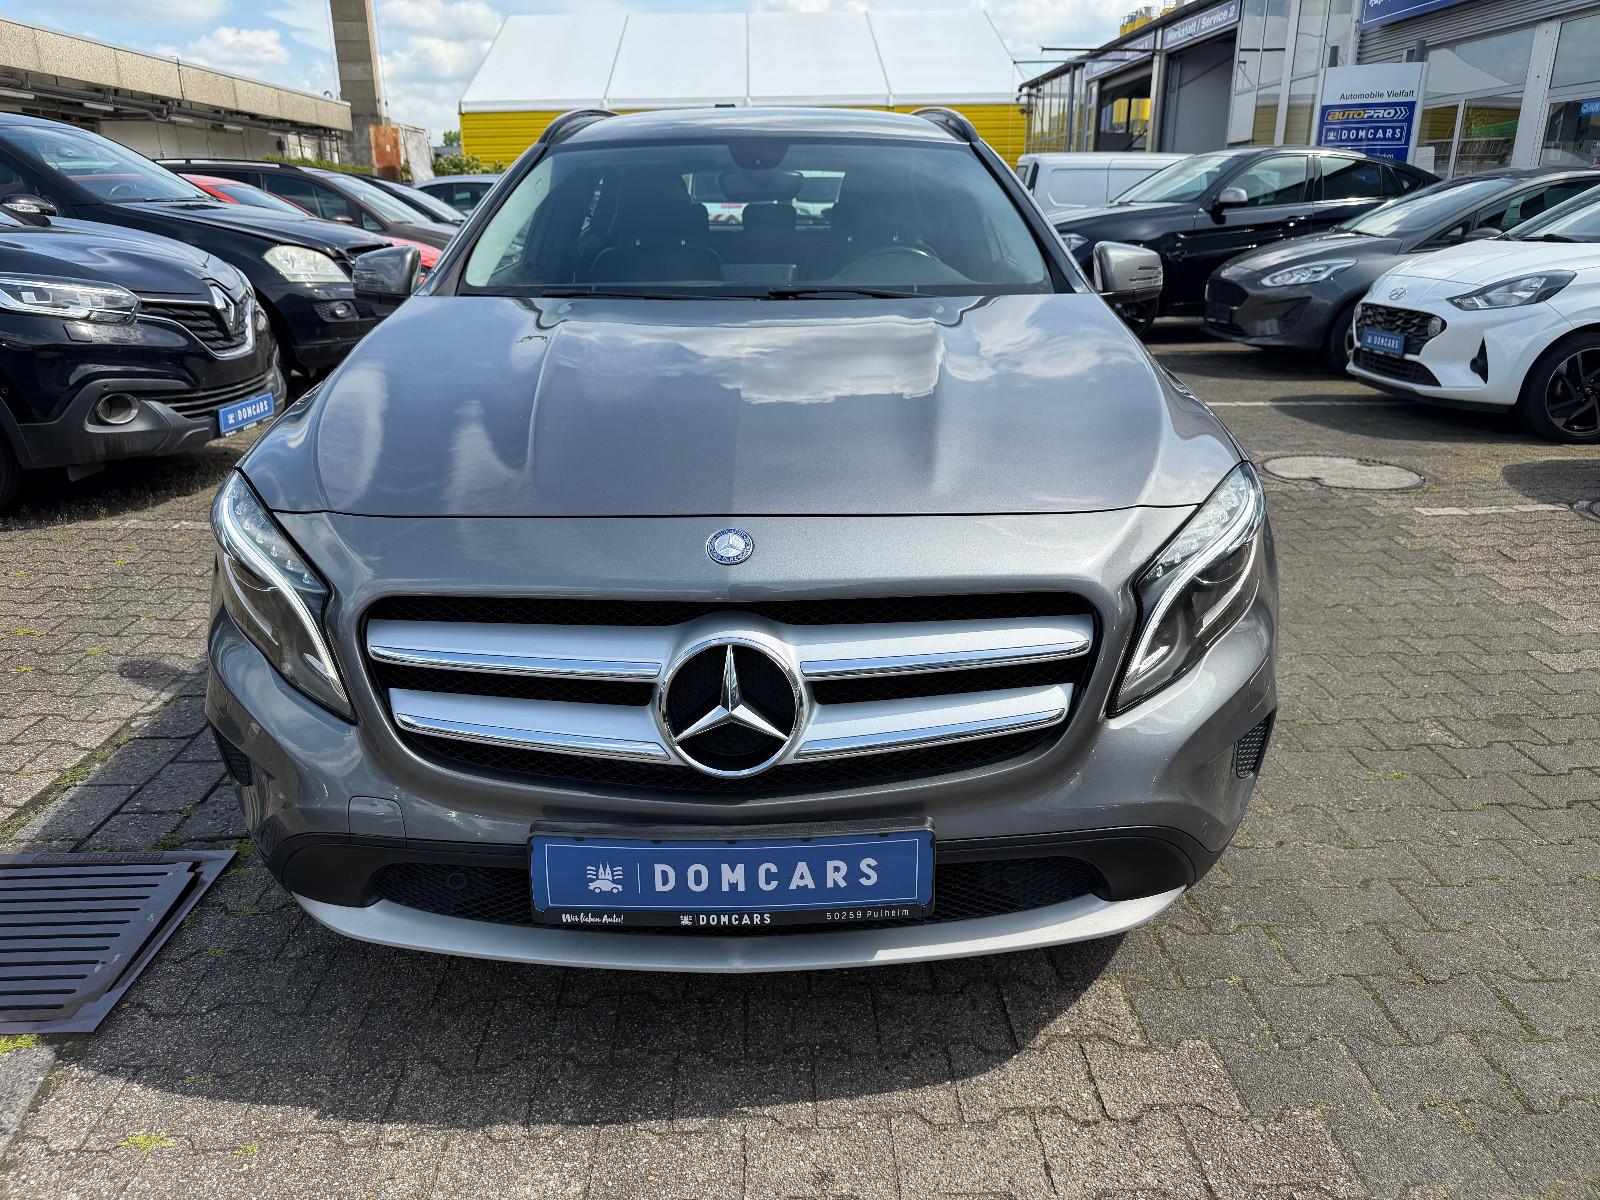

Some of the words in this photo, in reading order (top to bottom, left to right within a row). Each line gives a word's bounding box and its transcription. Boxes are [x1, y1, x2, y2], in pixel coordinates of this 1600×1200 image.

[1201, 10, 1228, 28] Service
[1228, 4, 1236, 18] 2
[1340, 90, 1384, 101] Automobile
[1386, 89, 1415, 98] Vielfalt
[1341, 128, 1401, 140] DOMCARS
[1373, 335, 1399, 349] DOMCARS
[237, 400, 268, 421] DOMCARS
[653, 857, 879, 892] DOMCARS
[580, 912, 601, 923] lieben
[700, 913, 771, 925] DOMCARS
[826, 910, 862, 920] 50259
[866, 908, 909, 918] Pulheim
